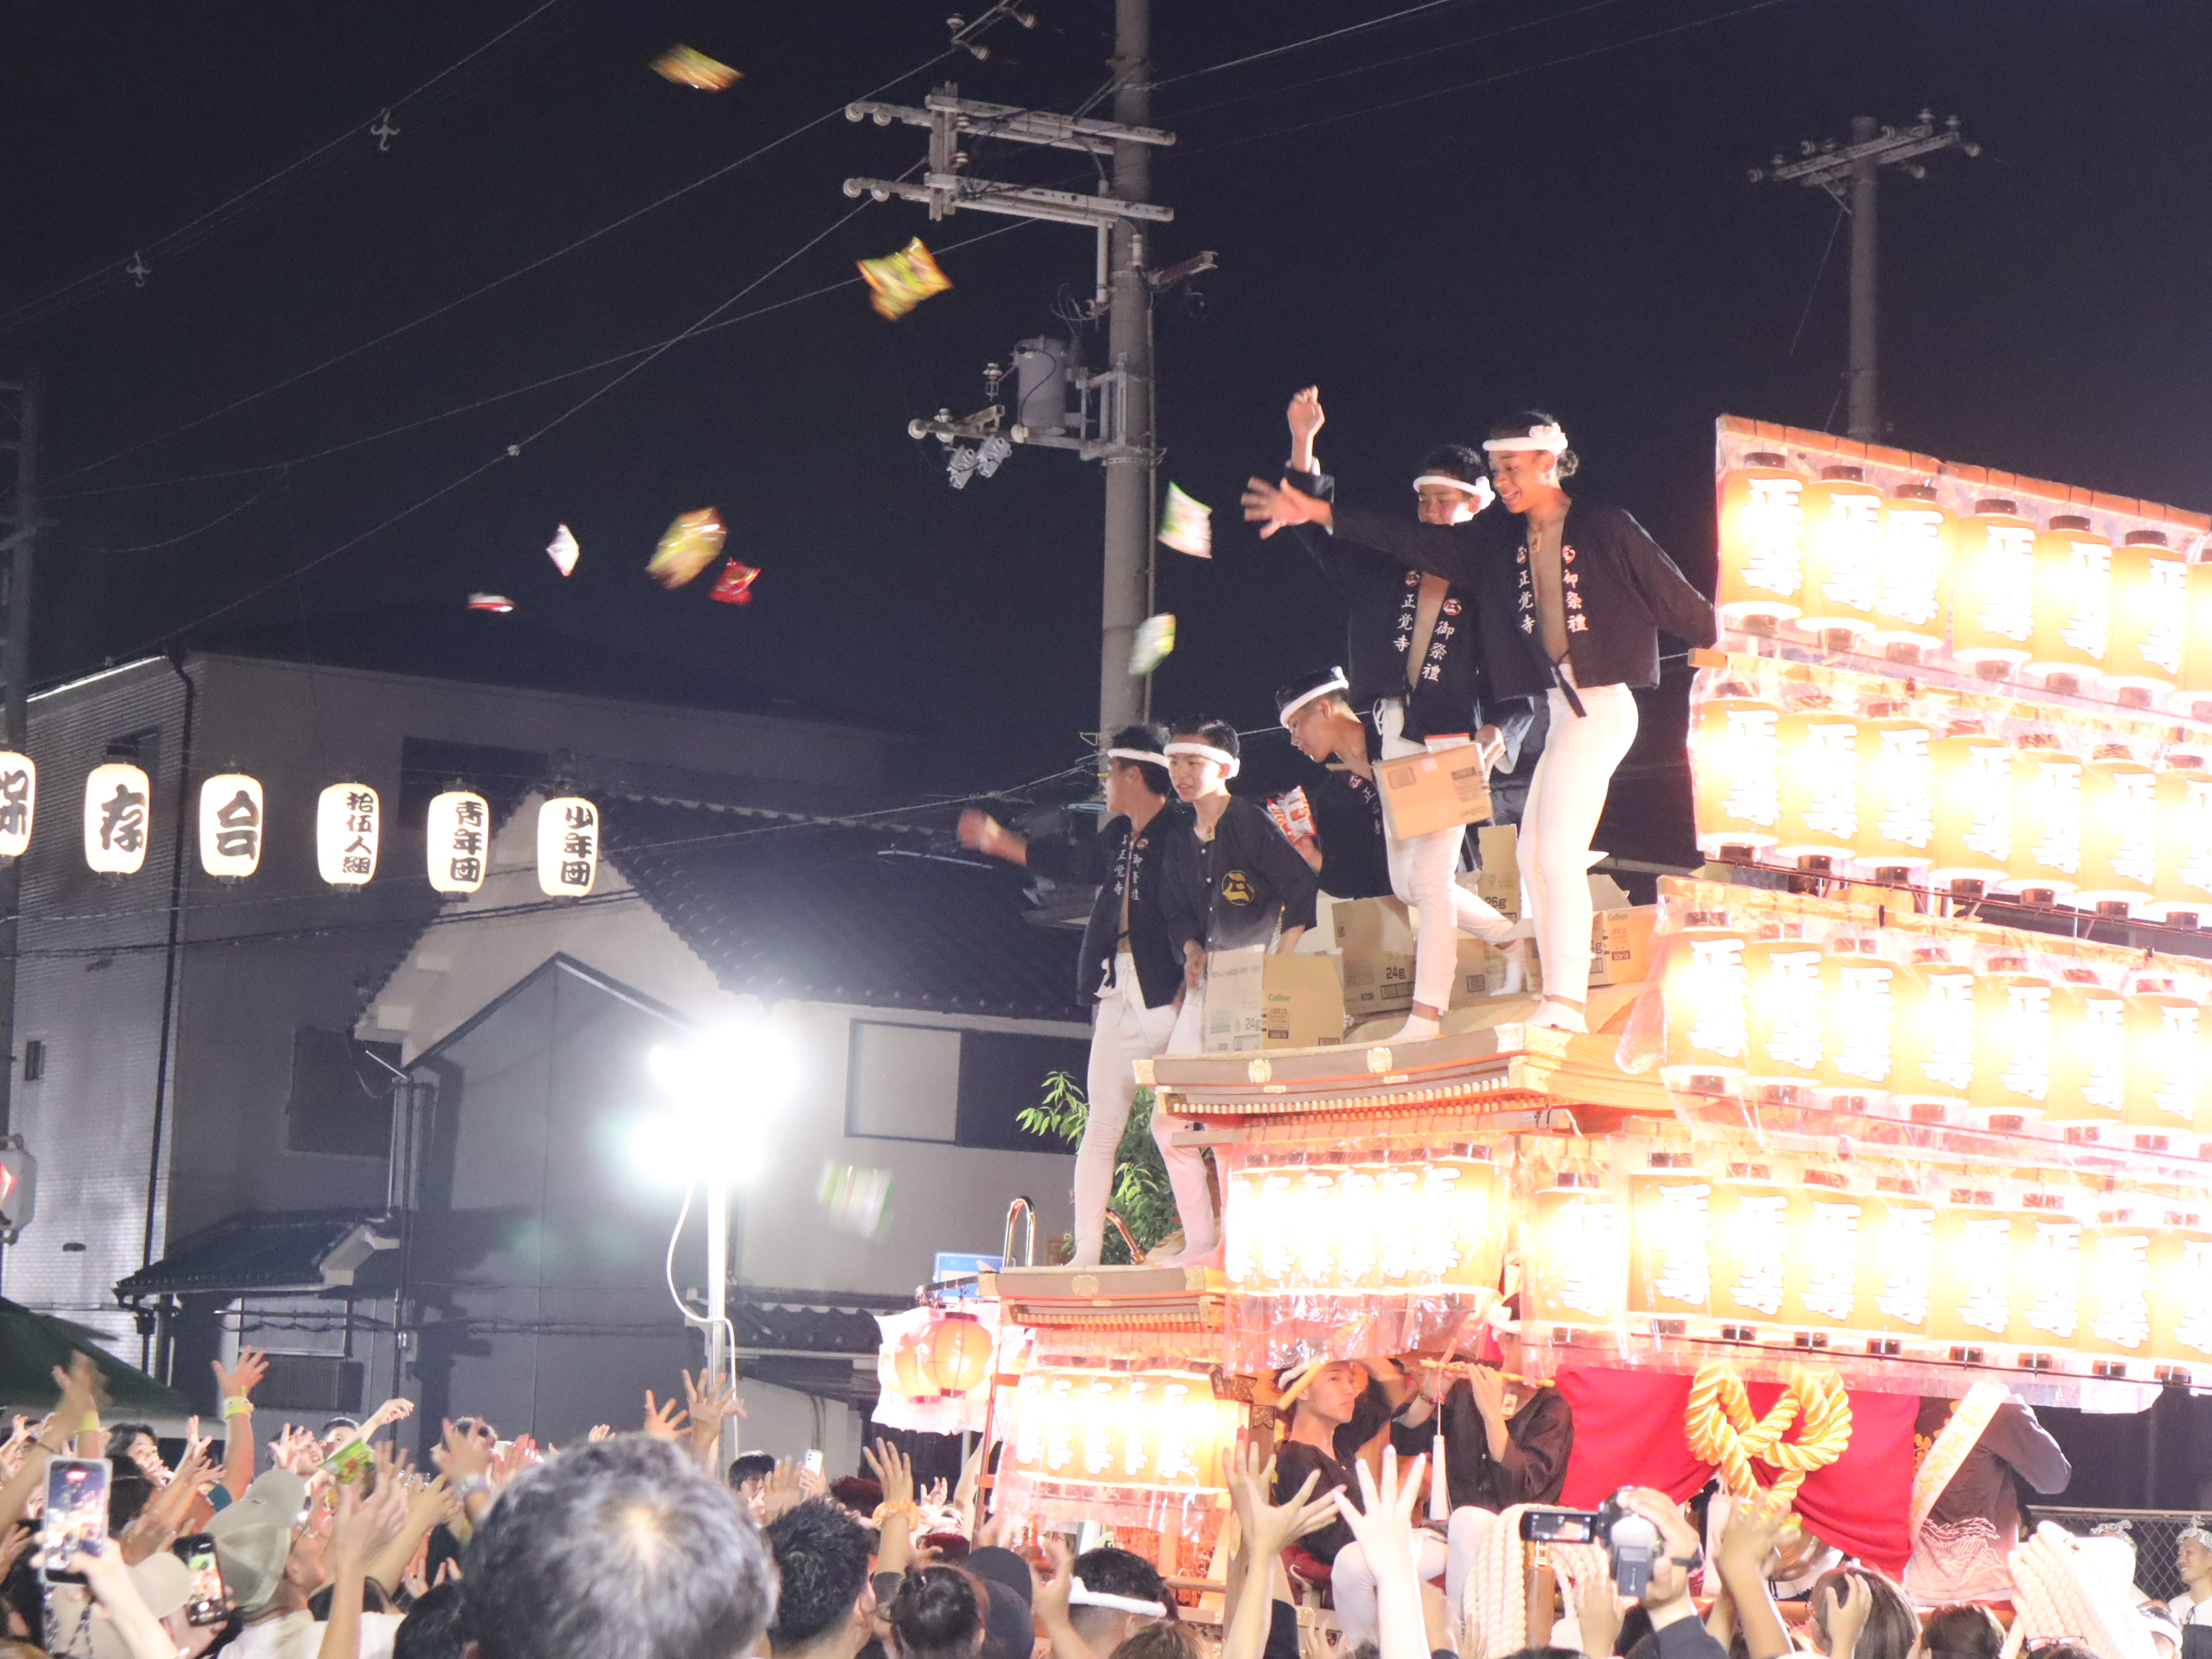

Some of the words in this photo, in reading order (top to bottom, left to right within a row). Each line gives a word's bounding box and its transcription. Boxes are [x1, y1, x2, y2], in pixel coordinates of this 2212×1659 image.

[1393, 594, 1416, 652] 正覚寺
[1518, 570, 1535, 634] 正覚寺
[342, 792, 373, 874] 拾伍人組
[451, 800, 483, 883] 青年団
[560, 806, 593, 886] 少年団
[1268, 994, 1290, 1002] Calbee
[1387, 967, 1406, 979] 24g
[1246, 1018, 1260, 1030] 24g
